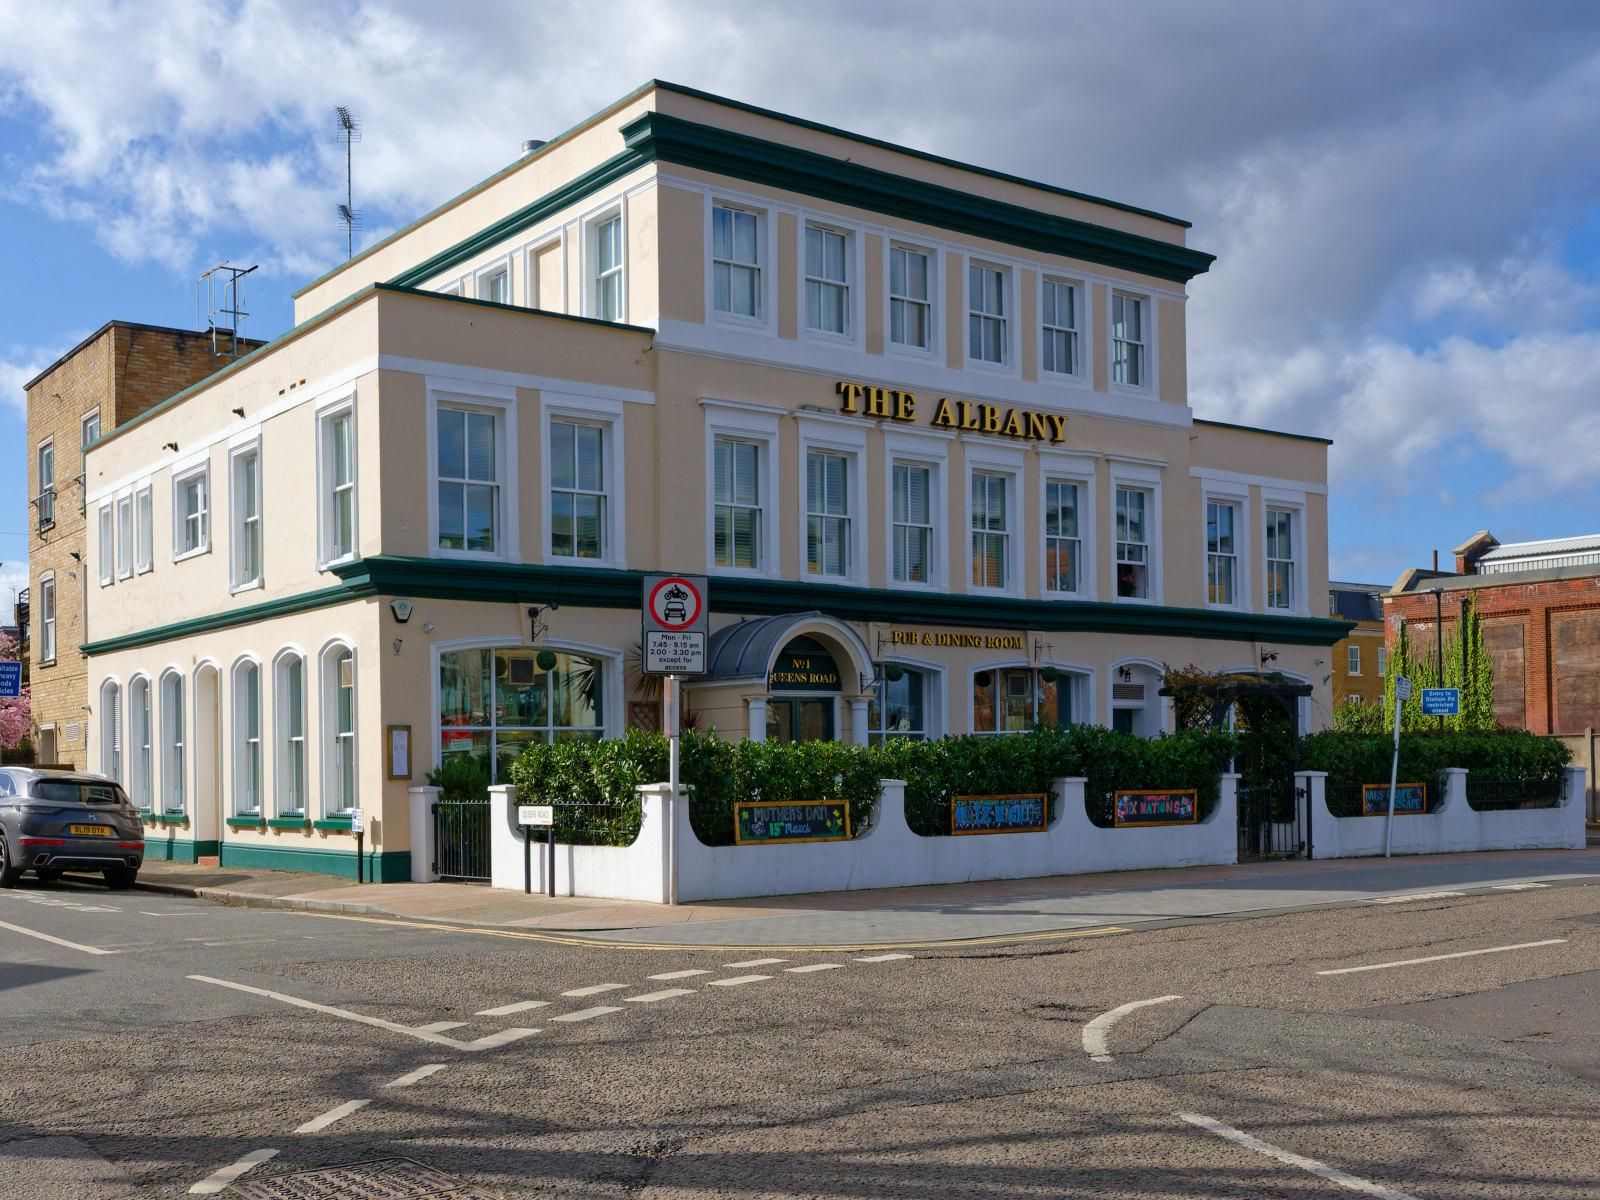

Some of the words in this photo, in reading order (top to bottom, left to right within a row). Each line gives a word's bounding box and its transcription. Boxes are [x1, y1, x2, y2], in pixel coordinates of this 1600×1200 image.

[836, 382, 916, 421] THE
[930, 398, 1069, 443] ALBANY
[892, 631, 919, 646] PUB
[923, 632, 933, 646] &
[936, 633, 983, 649] DINING
[986, 636, 1023, 650] ROOM
[809, 673, 837, 684] ROAD
[1140, 800, 1180, 815] NATIONS
